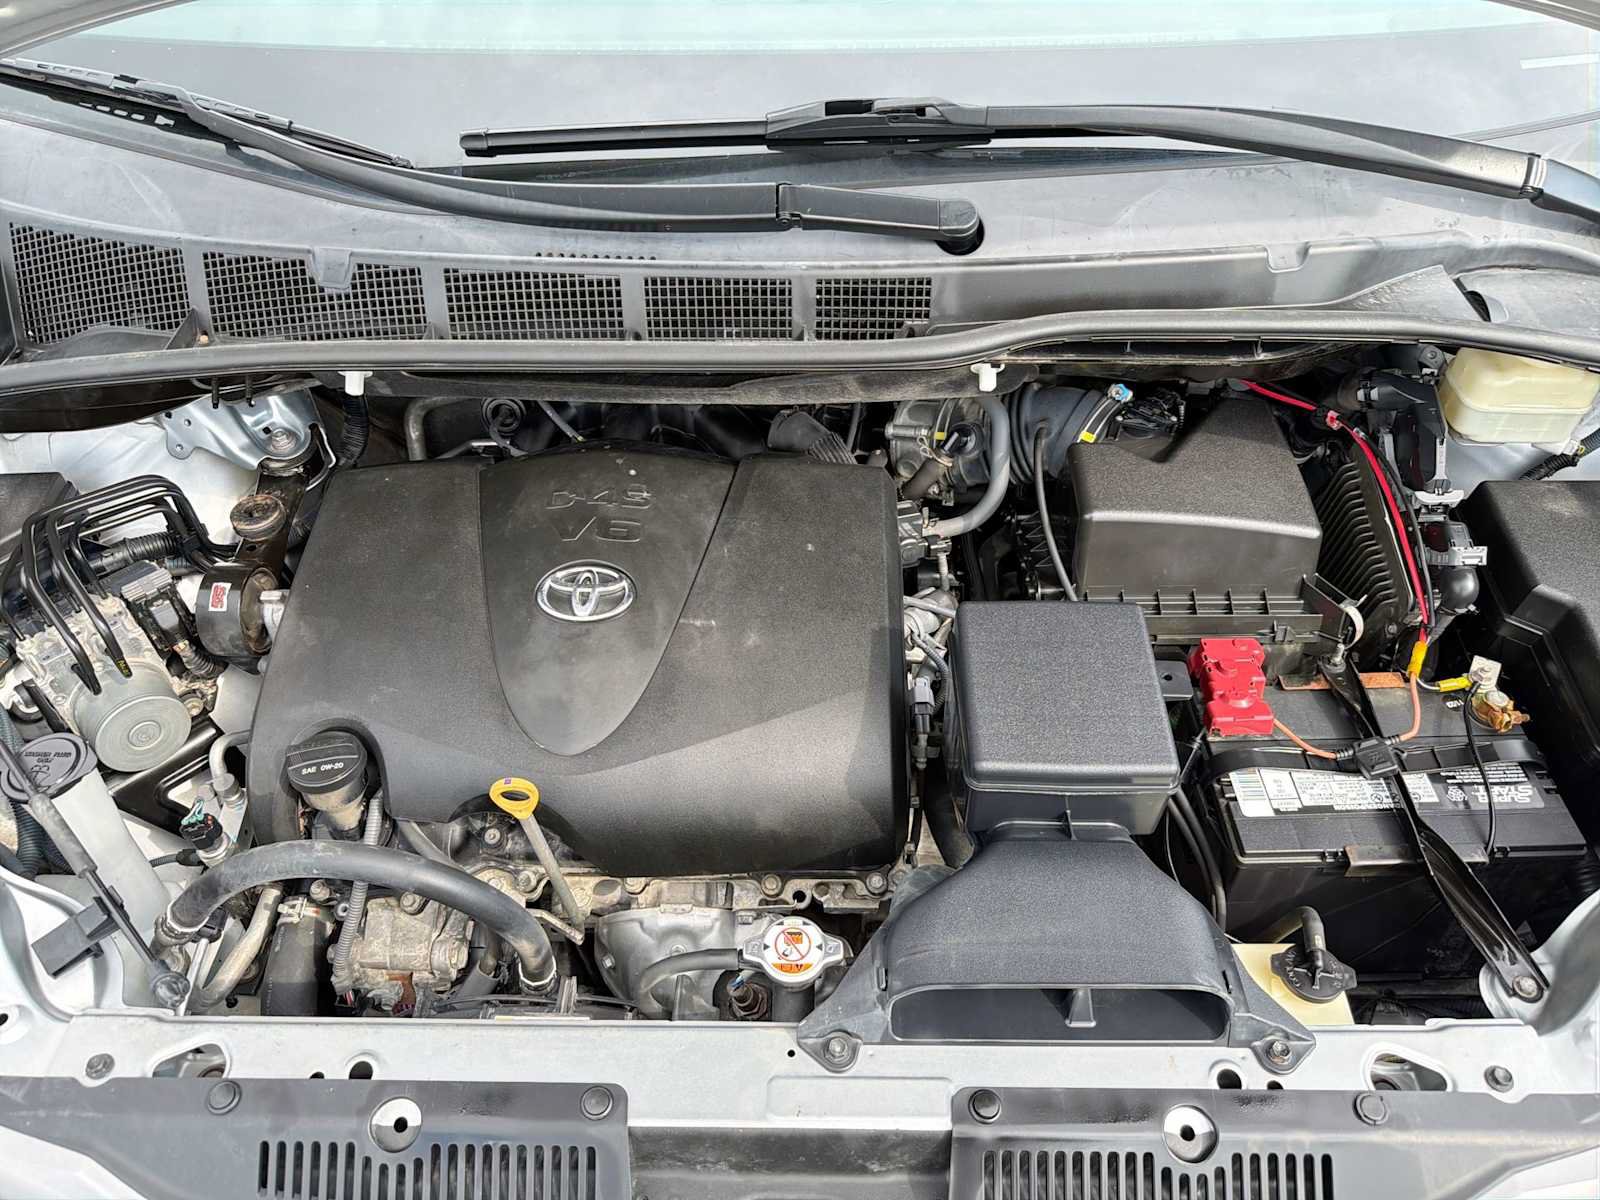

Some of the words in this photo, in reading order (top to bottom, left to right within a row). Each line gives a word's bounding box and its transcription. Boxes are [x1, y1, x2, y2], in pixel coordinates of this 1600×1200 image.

[556, 516, 643, 543] V6
[301, 766, 318, 775] SAE
[320, 762, 344, 771] 0W-20
